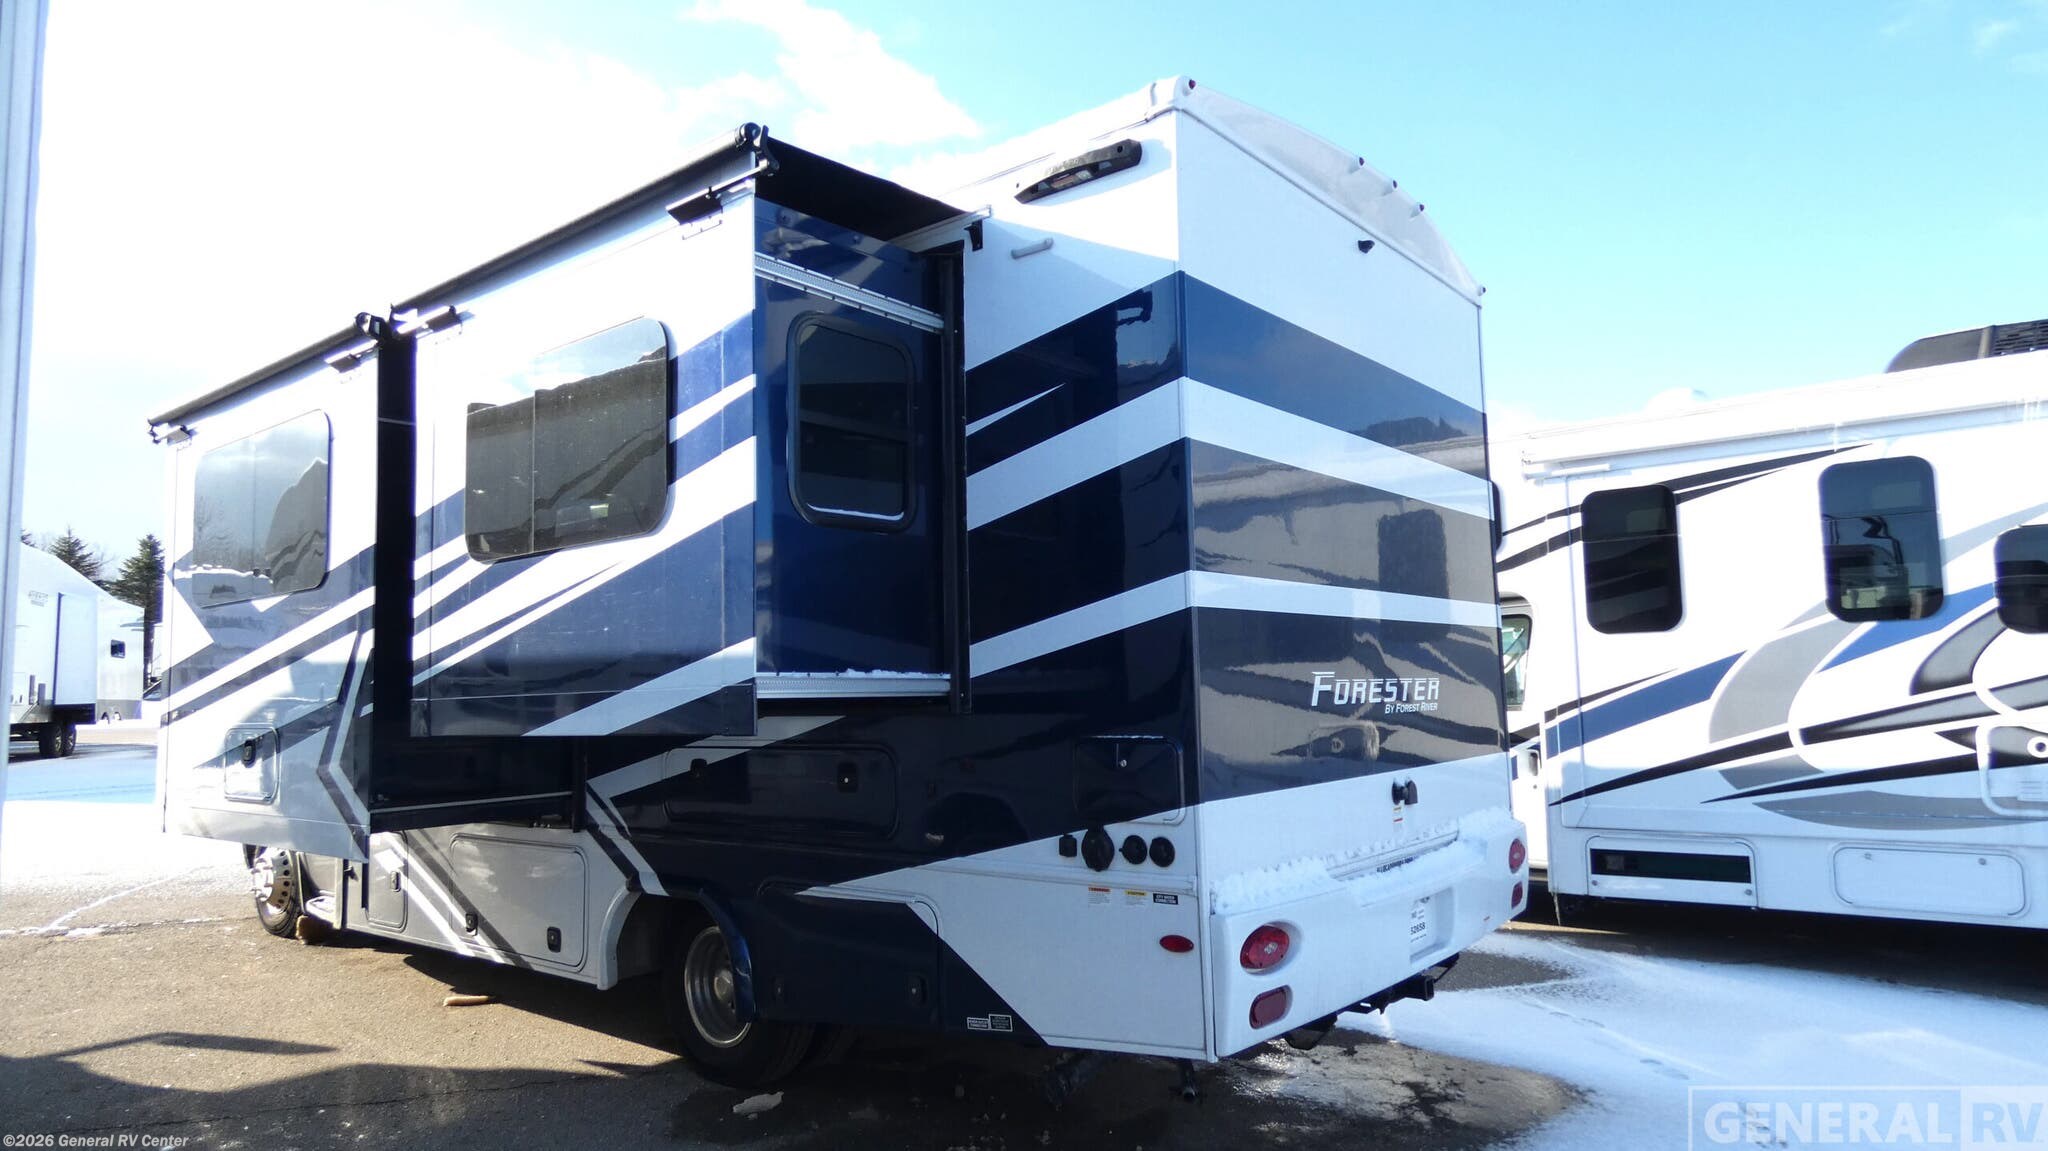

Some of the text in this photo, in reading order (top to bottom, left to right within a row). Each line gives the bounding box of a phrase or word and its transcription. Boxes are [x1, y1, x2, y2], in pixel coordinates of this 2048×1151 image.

[1311, 671, 1440, 706] FORESTER
[1385, 701, 1438, 714] BY FOREST RIVER
